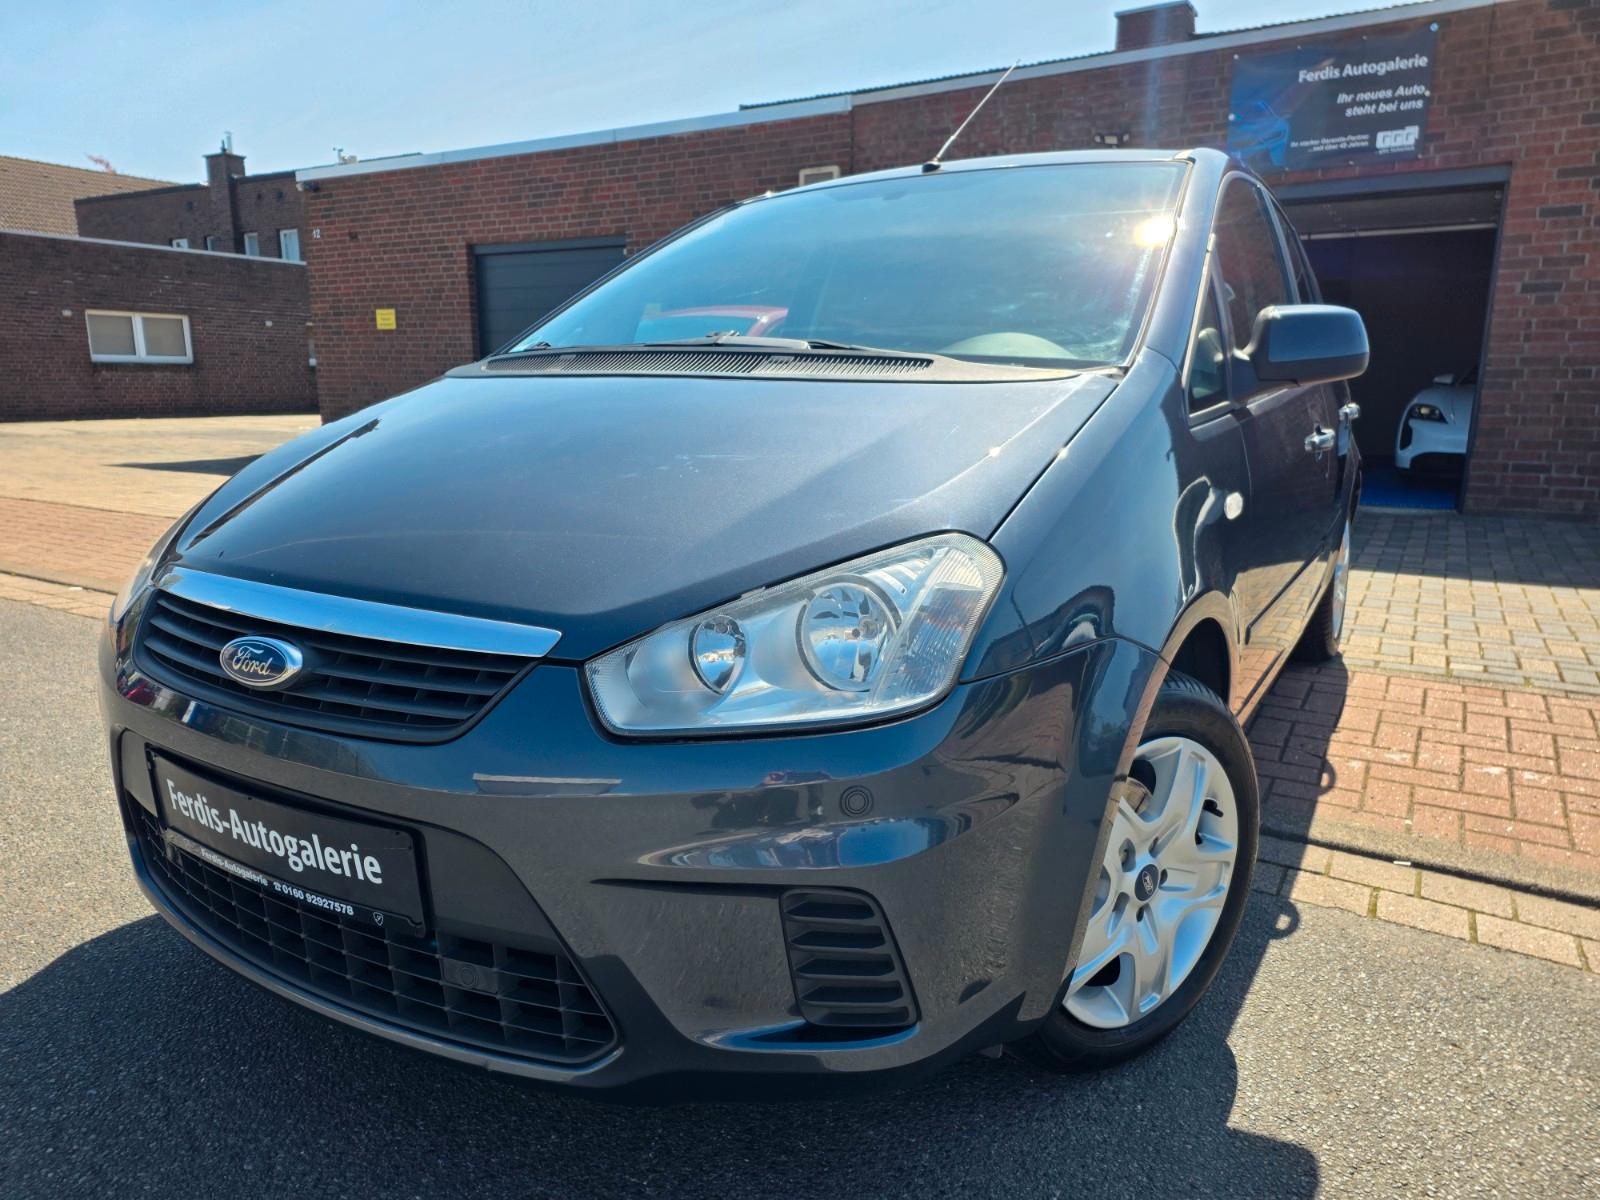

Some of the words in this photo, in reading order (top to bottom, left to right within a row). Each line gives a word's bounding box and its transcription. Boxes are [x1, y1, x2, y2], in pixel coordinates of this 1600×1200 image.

[1299, 66, 1340, 83] Ferdis
[1342, 54, 1428, 77] Autogalerie
[1337, 92, 1355, 104] Ihr
[1356, 89, 1393, 101] neues
[1394, 84, 1425, 97] Auto
[1345, 103, 1376, 117] steht
[1378, 100, 1398, 113] bei
[1399, 99, 1424, 111] uns
[232, 646, 273, 675] Ford
[166, 778, 383, 885] Ferdis-Autogalerie
[282, 884, 304, 900] 0160
[305, 893, 354, 916] 92927578
